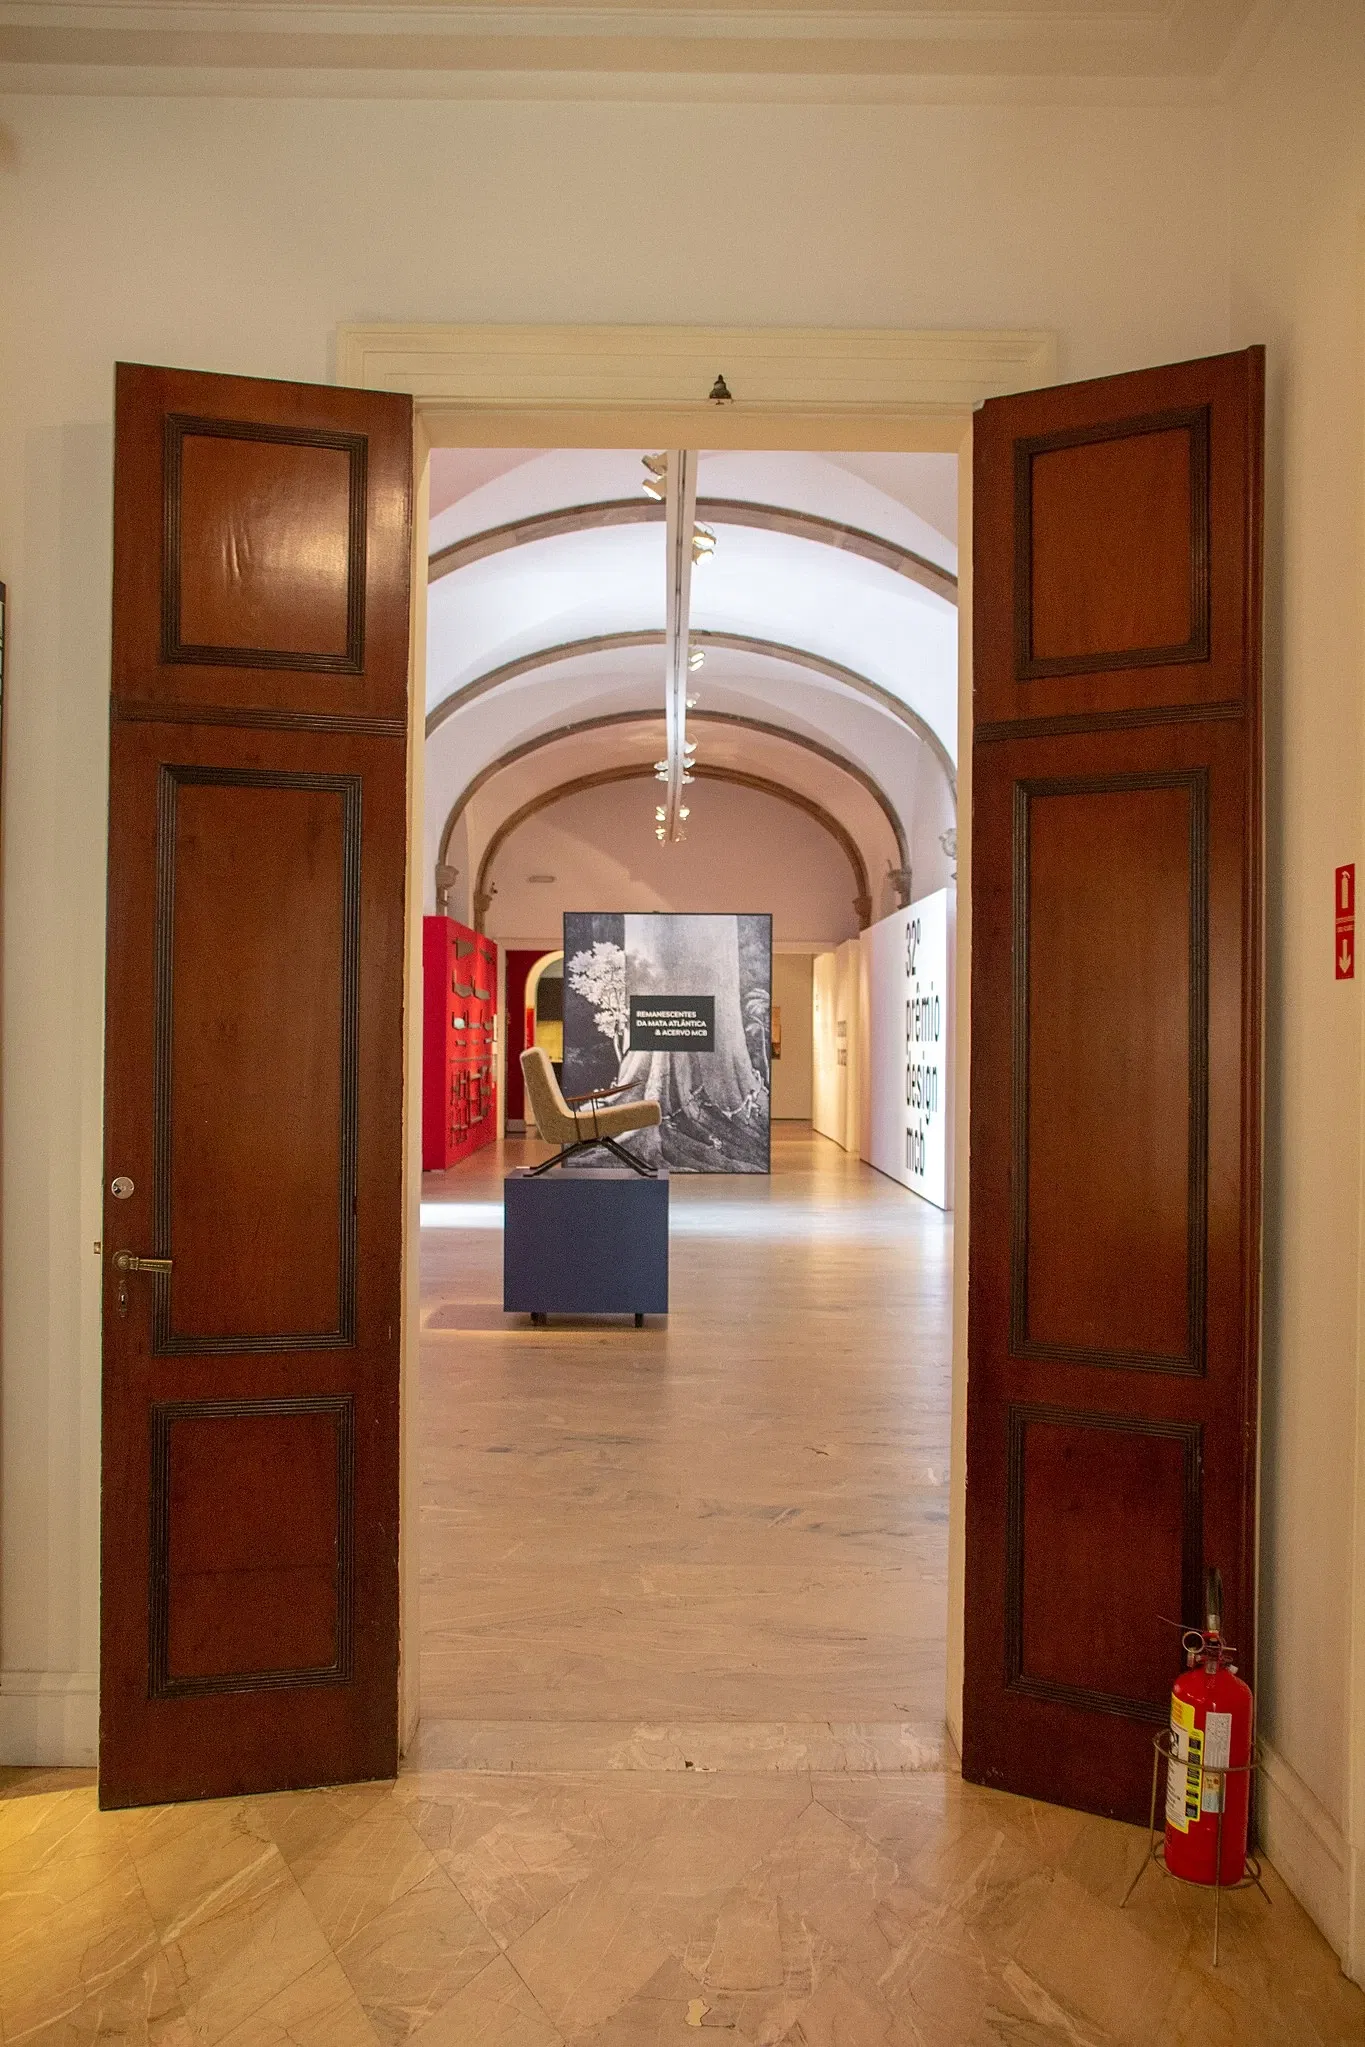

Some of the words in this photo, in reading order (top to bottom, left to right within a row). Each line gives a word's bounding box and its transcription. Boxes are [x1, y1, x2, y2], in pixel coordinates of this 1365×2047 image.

[669, 1019, 707, 1027] ATLÂNTICA
[906, 981, 940, 1055] prêmio
[906, 1050, 938, 1125] design
[906, 1118, 925, 1176] mcb
